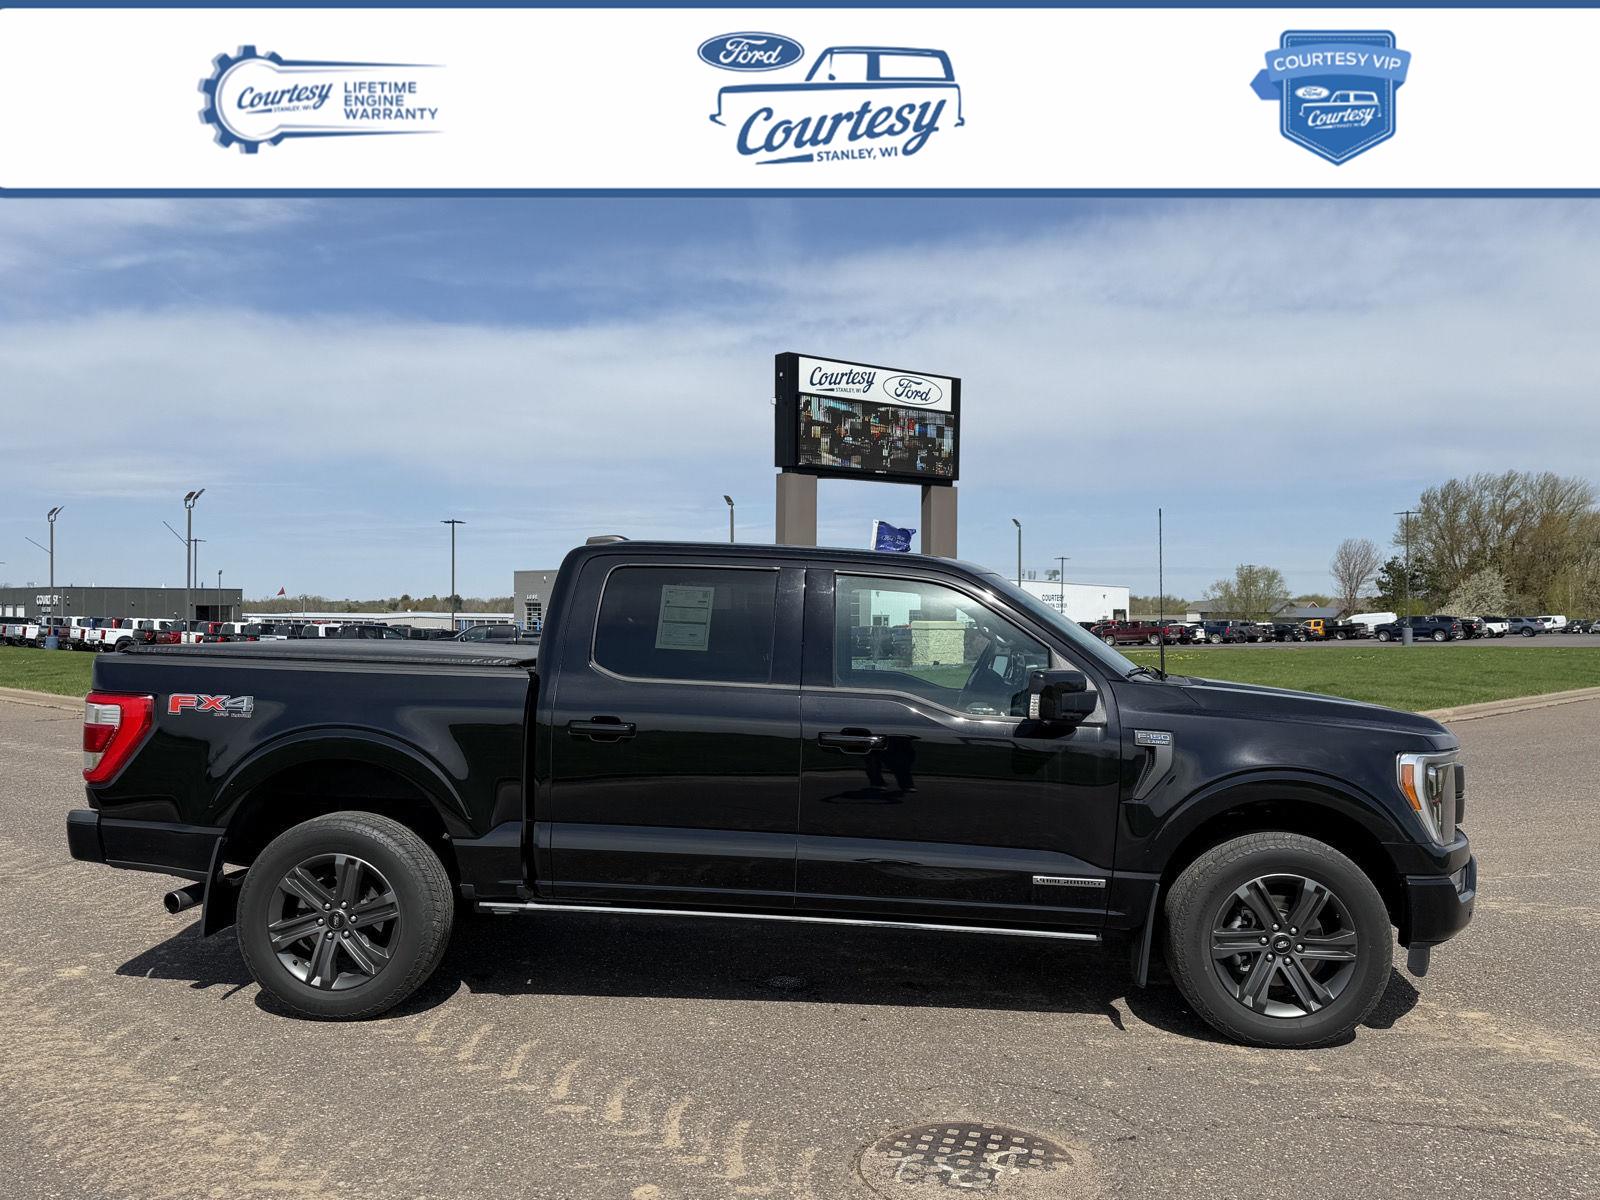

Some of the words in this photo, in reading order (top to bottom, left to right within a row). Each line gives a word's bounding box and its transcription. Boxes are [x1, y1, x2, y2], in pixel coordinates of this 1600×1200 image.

[809, 366, 876, 394] Courtesy
[894, 378, 931, 402] Ford
[168, 694, 253, 715] FX4
